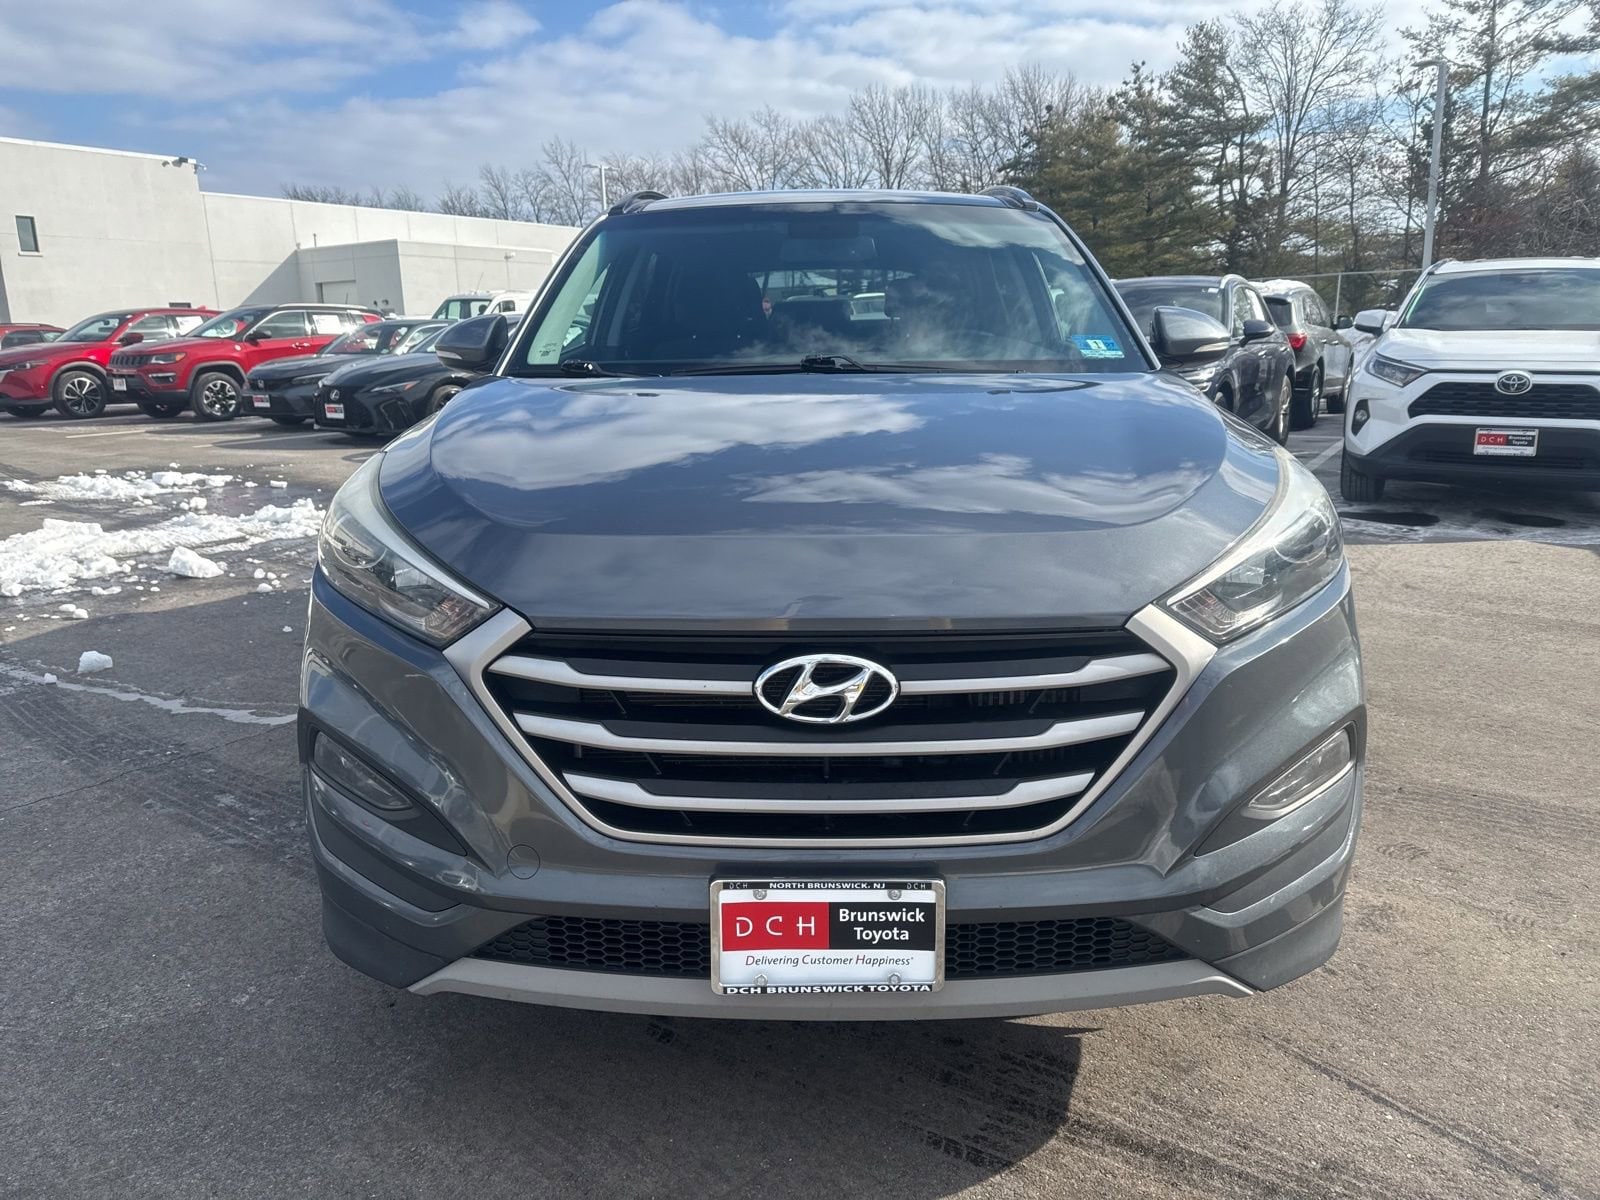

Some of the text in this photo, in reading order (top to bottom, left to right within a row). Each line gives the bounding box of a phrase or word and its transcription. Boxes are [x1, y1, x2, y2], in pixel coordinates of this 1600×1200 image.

[839, 907, 925, 922] Brunswick
[853, 926, 909, 944] Toyota
[745, 955, 799, 967] Delivering
[801, 954, 853, 966] Customer
